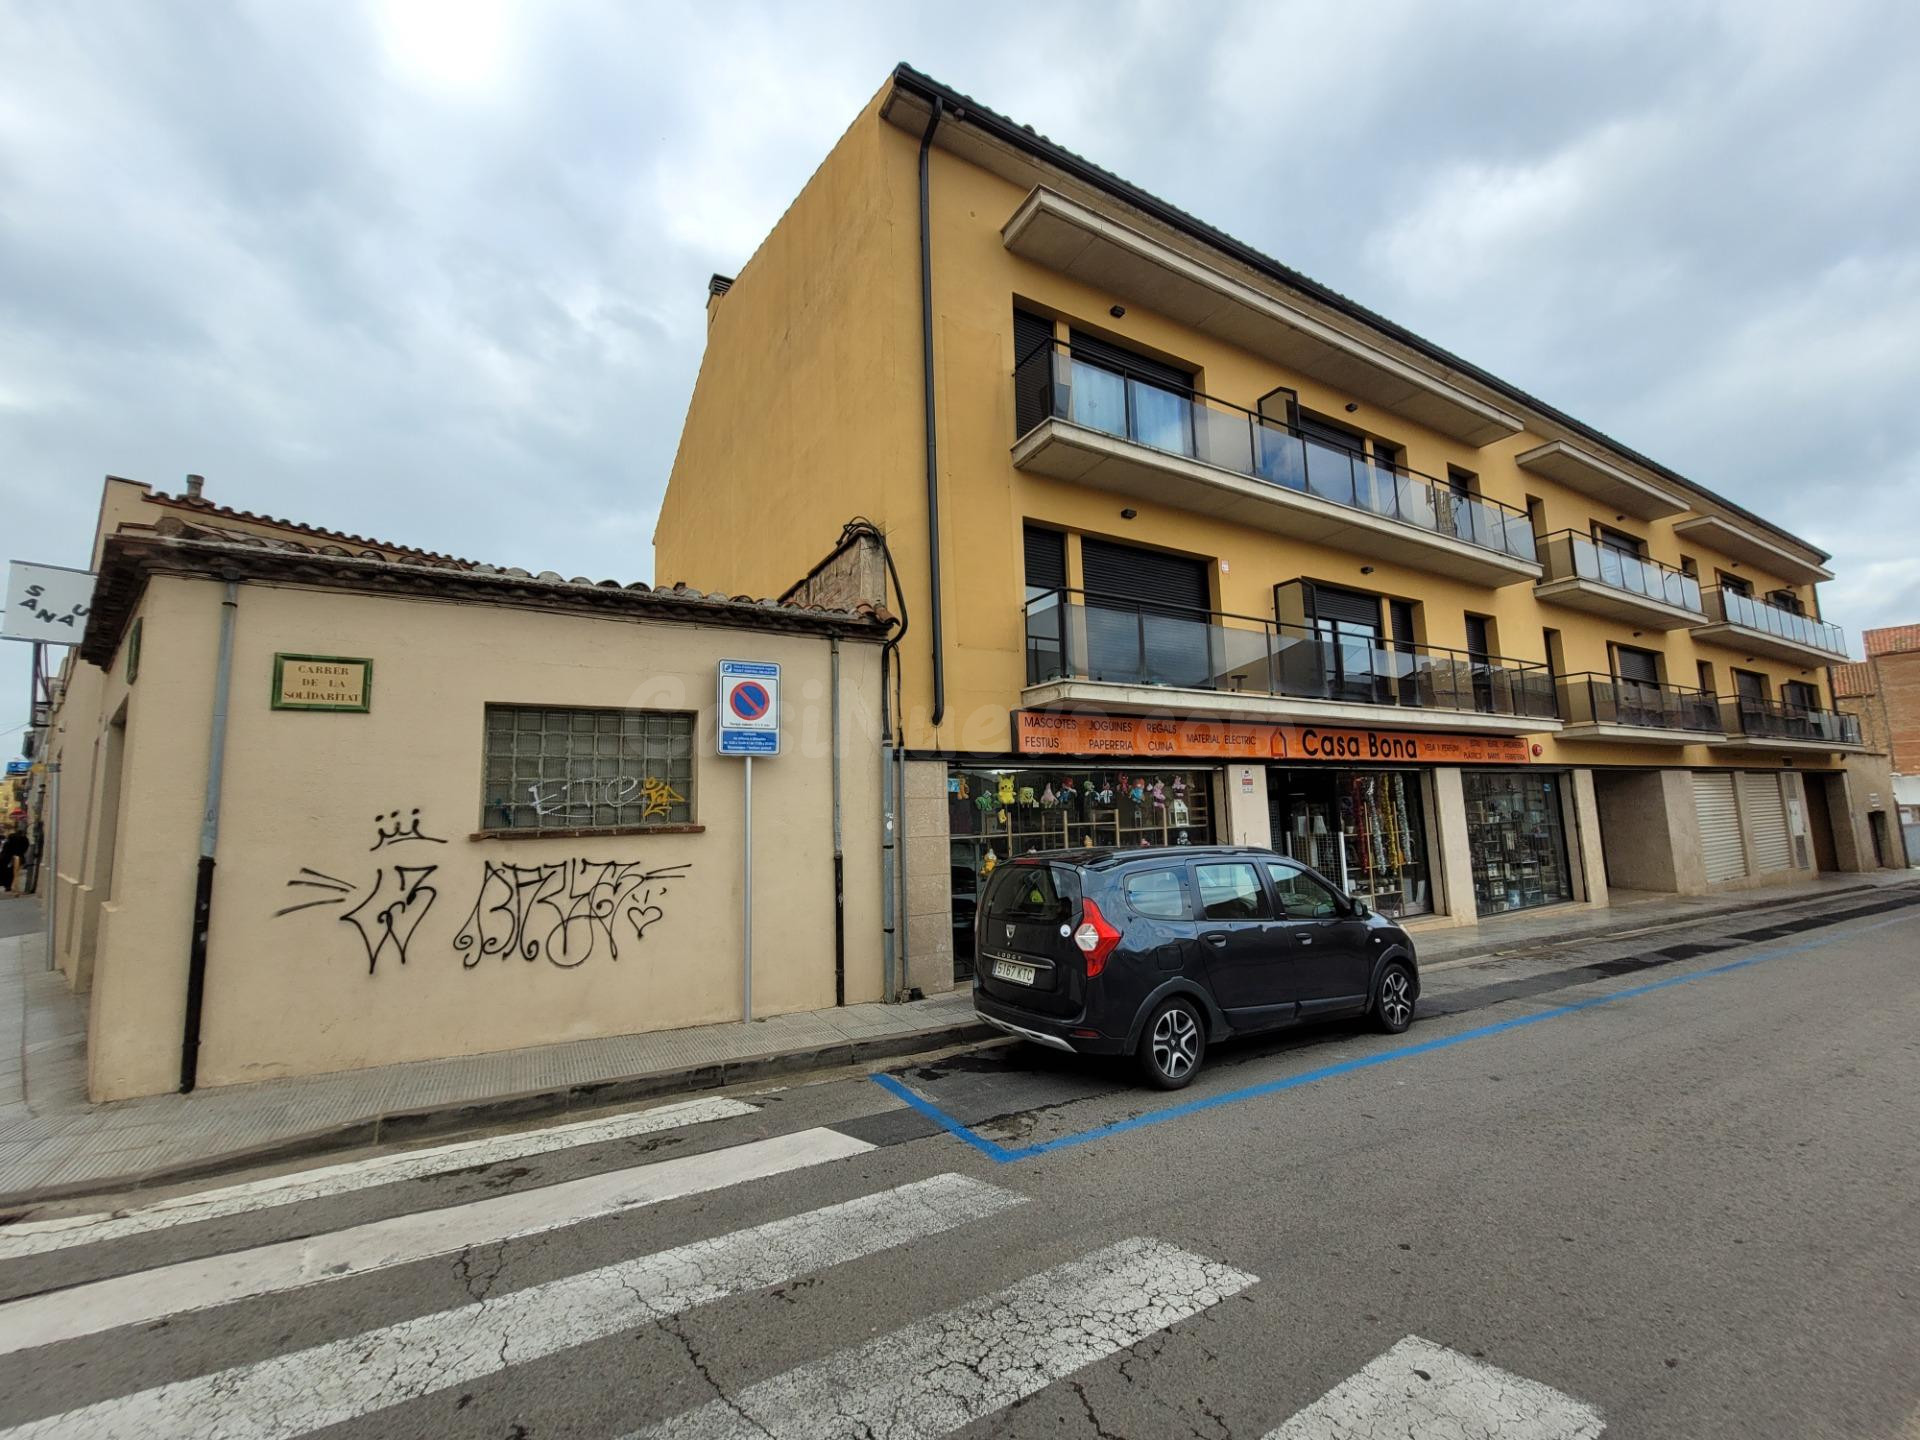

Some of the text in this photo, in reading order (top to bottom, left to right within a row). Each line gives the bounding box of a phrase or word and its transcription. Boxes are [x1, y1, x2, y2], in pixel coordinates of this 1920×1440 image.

[298, 665, 349, 675] CARRER
[302, 678, 345, 688] DE LA
[284, 691, 361, 702] SOLIDARITAT
[1024, 717, 1176, 734] MASCOTES JOGUINES REGALS
[1025, 736, 1174, 751] FESTIUS PAPERERIA CUINA
[1186, 734, 1256, 745] MATERIAL ELECTRIC
[1302, 729, 1417, 758] Casa Bona
